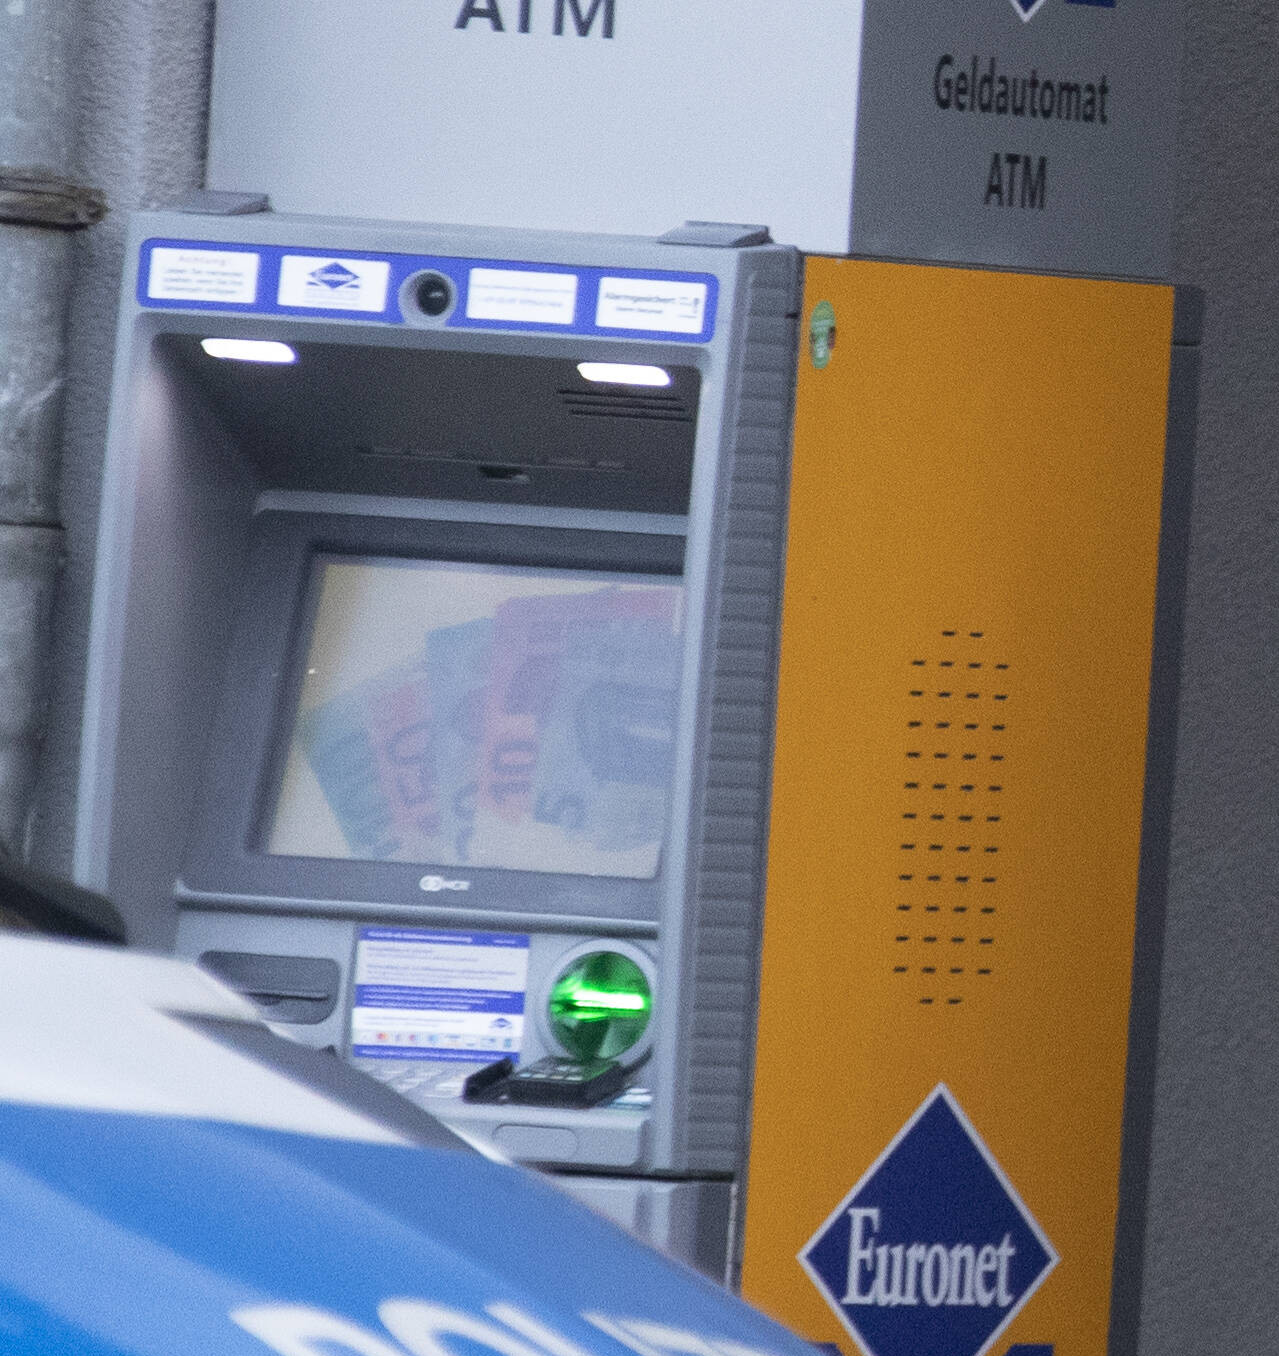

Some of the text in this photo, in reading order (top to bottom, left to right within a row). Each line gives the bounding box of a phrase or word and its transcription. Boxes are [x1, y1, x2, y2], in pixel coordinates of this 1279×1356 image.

[934, 53, 1110, 125] Geldautomat
[984, 152, 1048, 209] ATM
[841, 1207, 1016, 1307] Euronet
